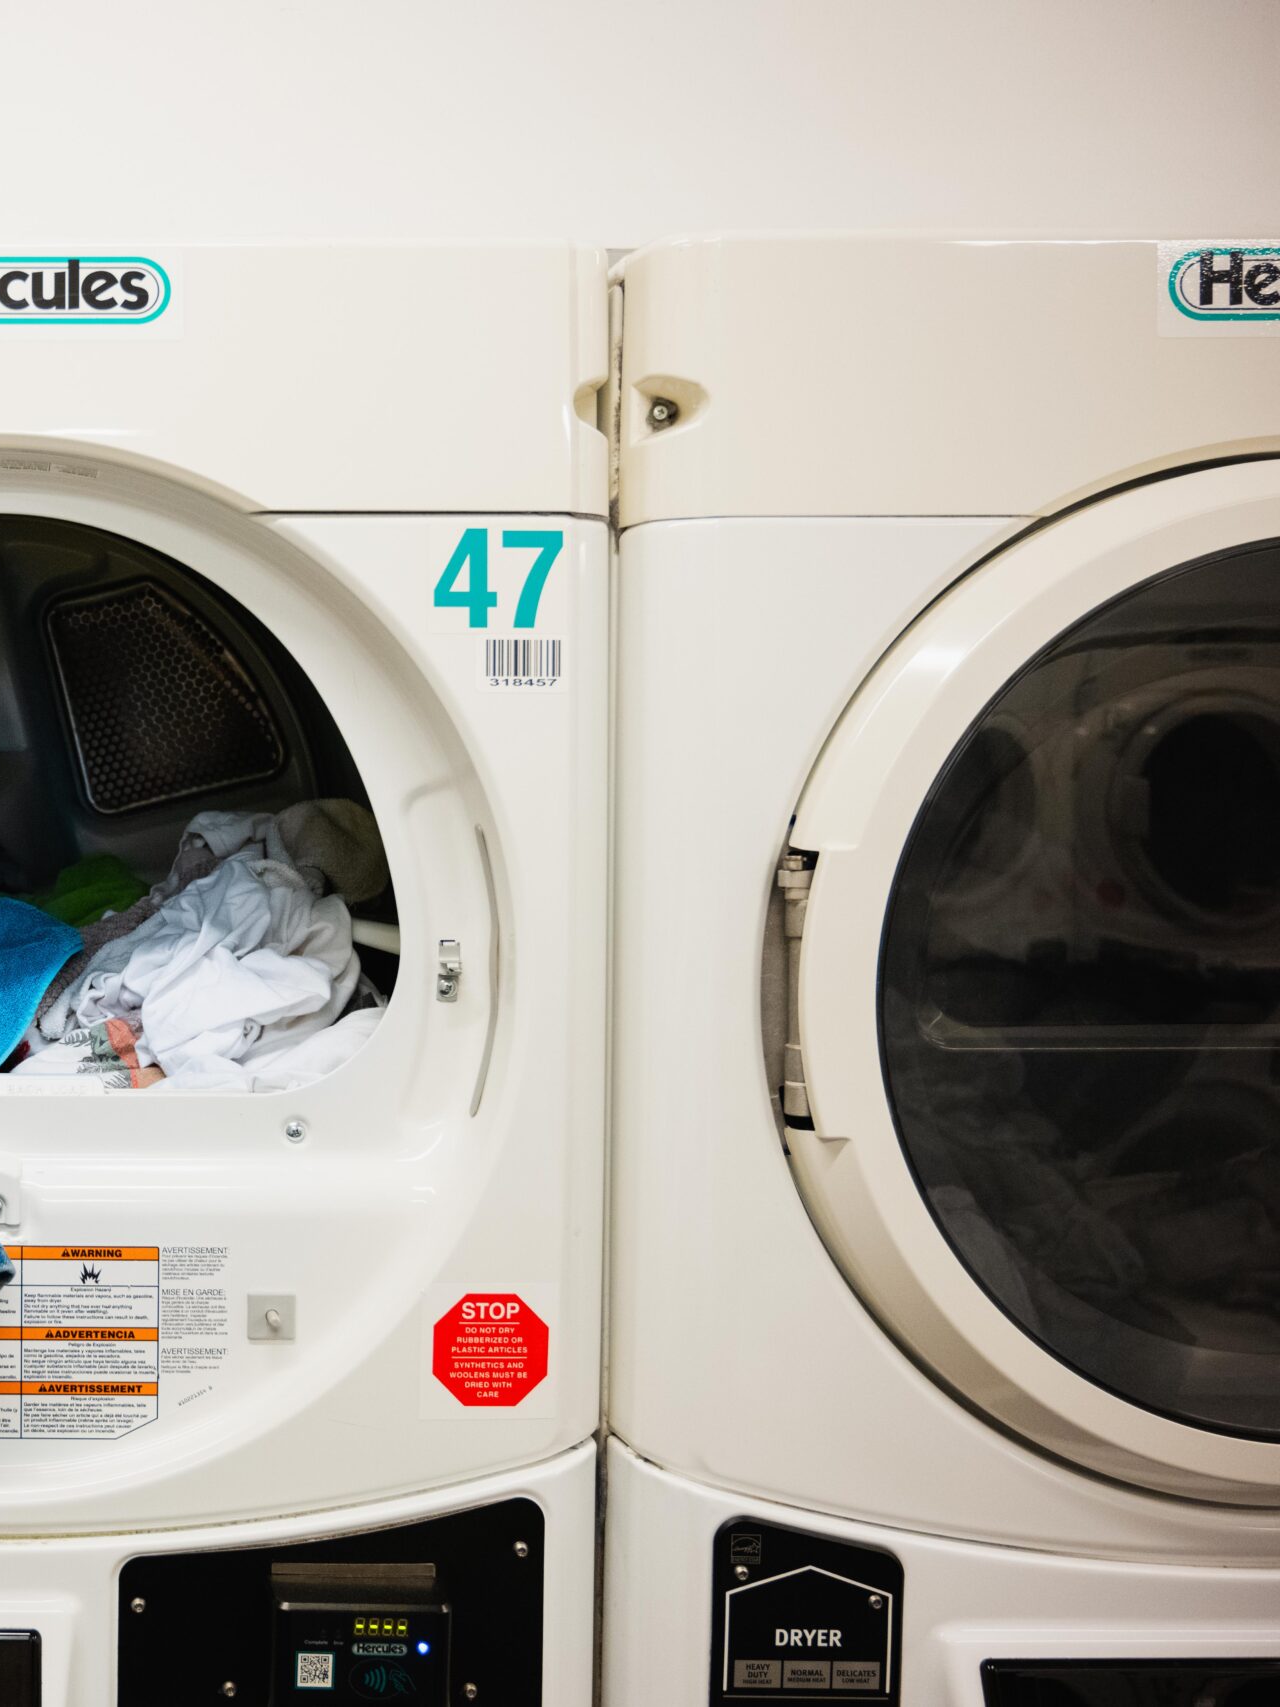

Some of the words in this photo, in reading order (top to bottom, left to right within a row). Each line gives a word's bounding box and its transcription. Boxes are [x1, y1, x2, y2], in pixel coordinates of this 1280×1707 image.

[434, 528, 564, 629] 47
[489, 678, 557, 687] 318457
[70, 1249, 122, 1258] WARNING
[462, 1302, 520, 1320] STOP
[55, 1330, 135, 1339] ADVERTENCIA
[48, 1384, 142, 1393] AVERTISSEMENT
[775, 1629, 842, 1647] DRYER
[357, 1643, 404, 1654] Hercules
